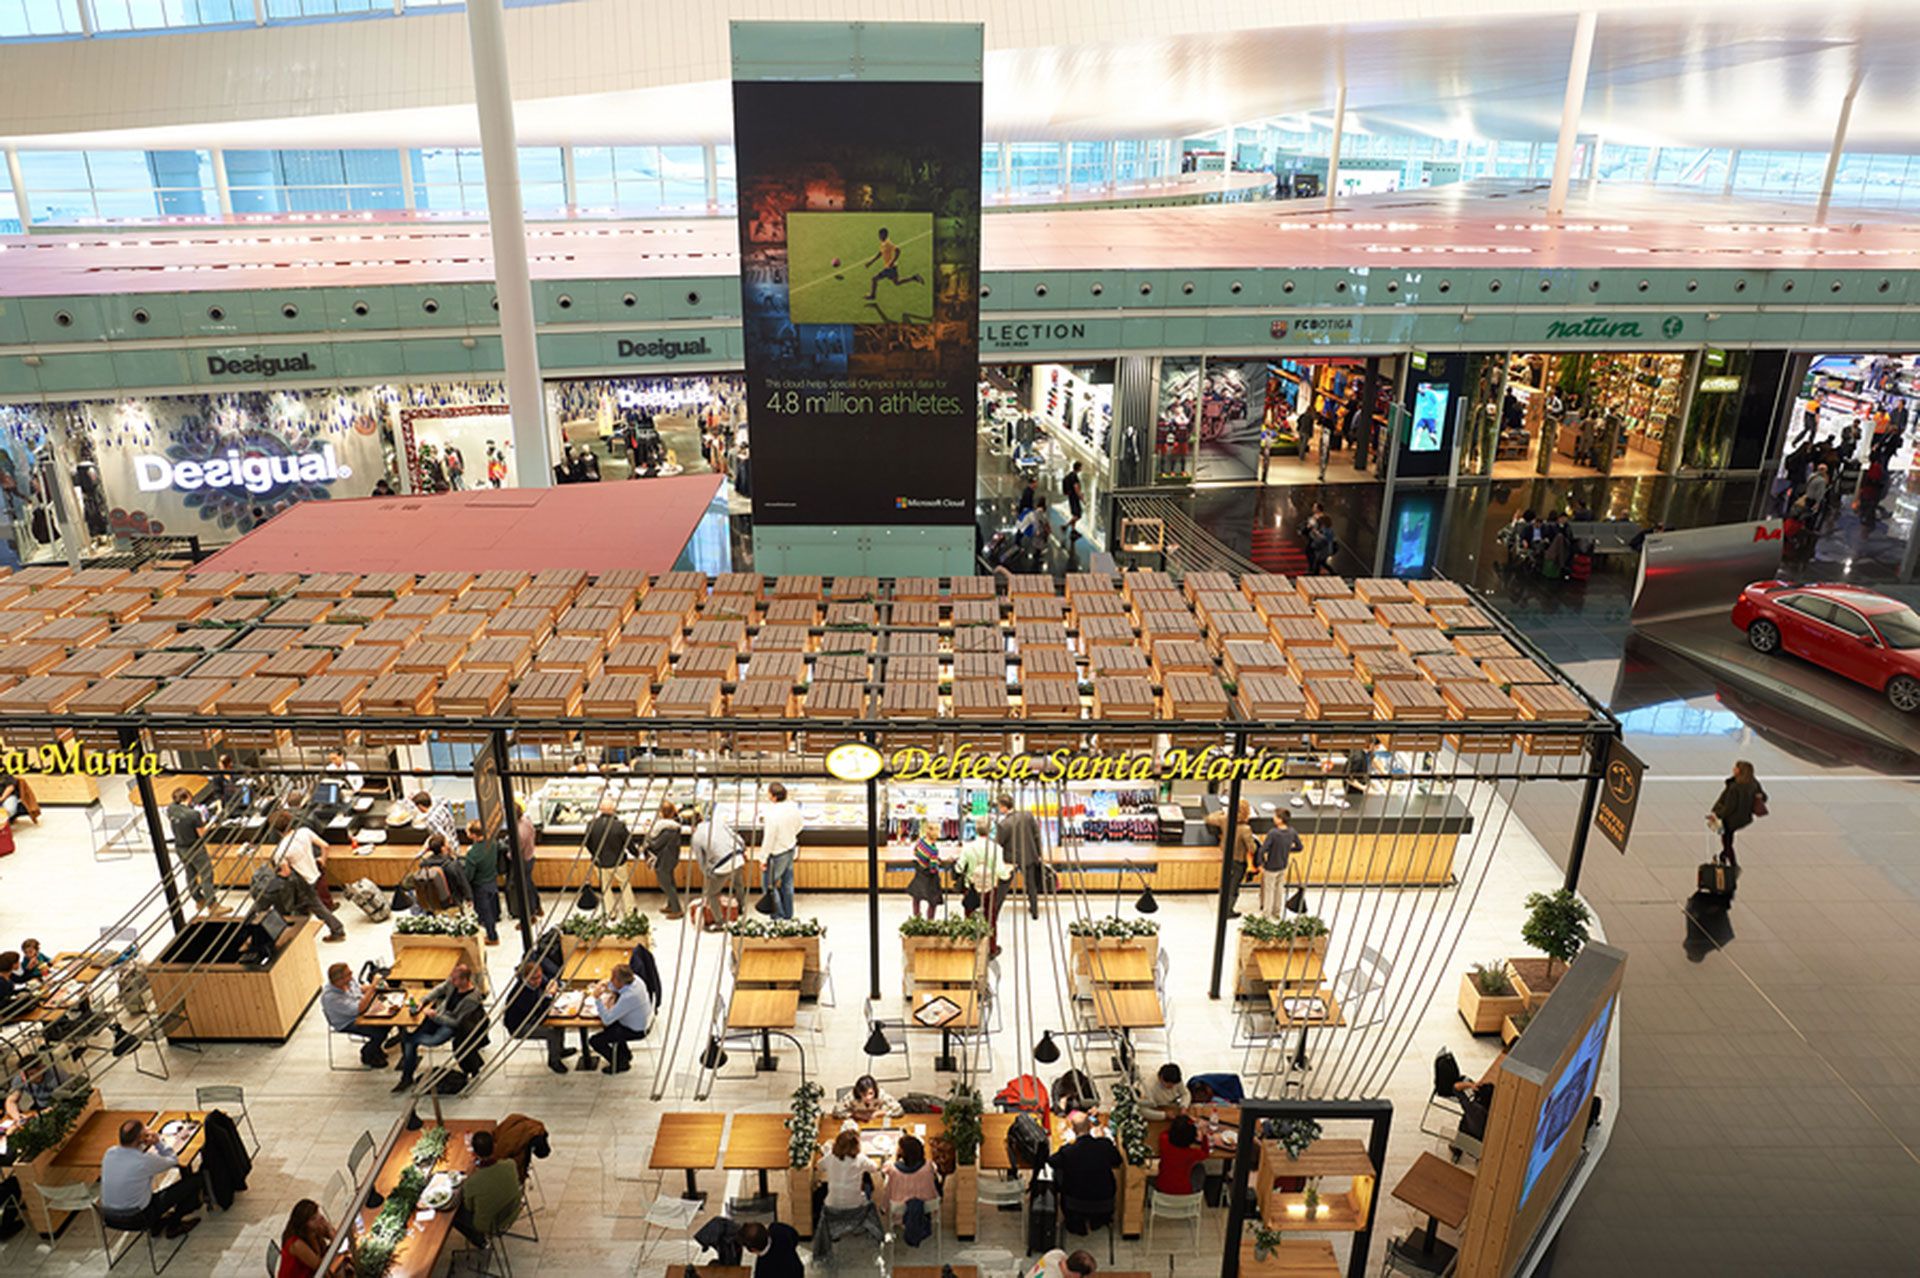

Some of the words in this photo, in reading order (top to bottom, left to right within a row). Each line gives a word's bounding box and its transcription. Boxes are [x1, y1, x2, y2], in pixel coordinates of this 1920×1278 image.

[1546, 316, 1643, 339] natura
[766, 391, 800, 414] 4.8
[805, 391, 873, 413] million
[879, 390, 963, 414] athletes.
[942, 498, 966, 508] Cloud
[39, 739, 164, 776] María
[889, 743, 1033, 781] Dehesa
[1039, 747, 1153, 782] Santa
[1161, 744, 1285, 781] María
